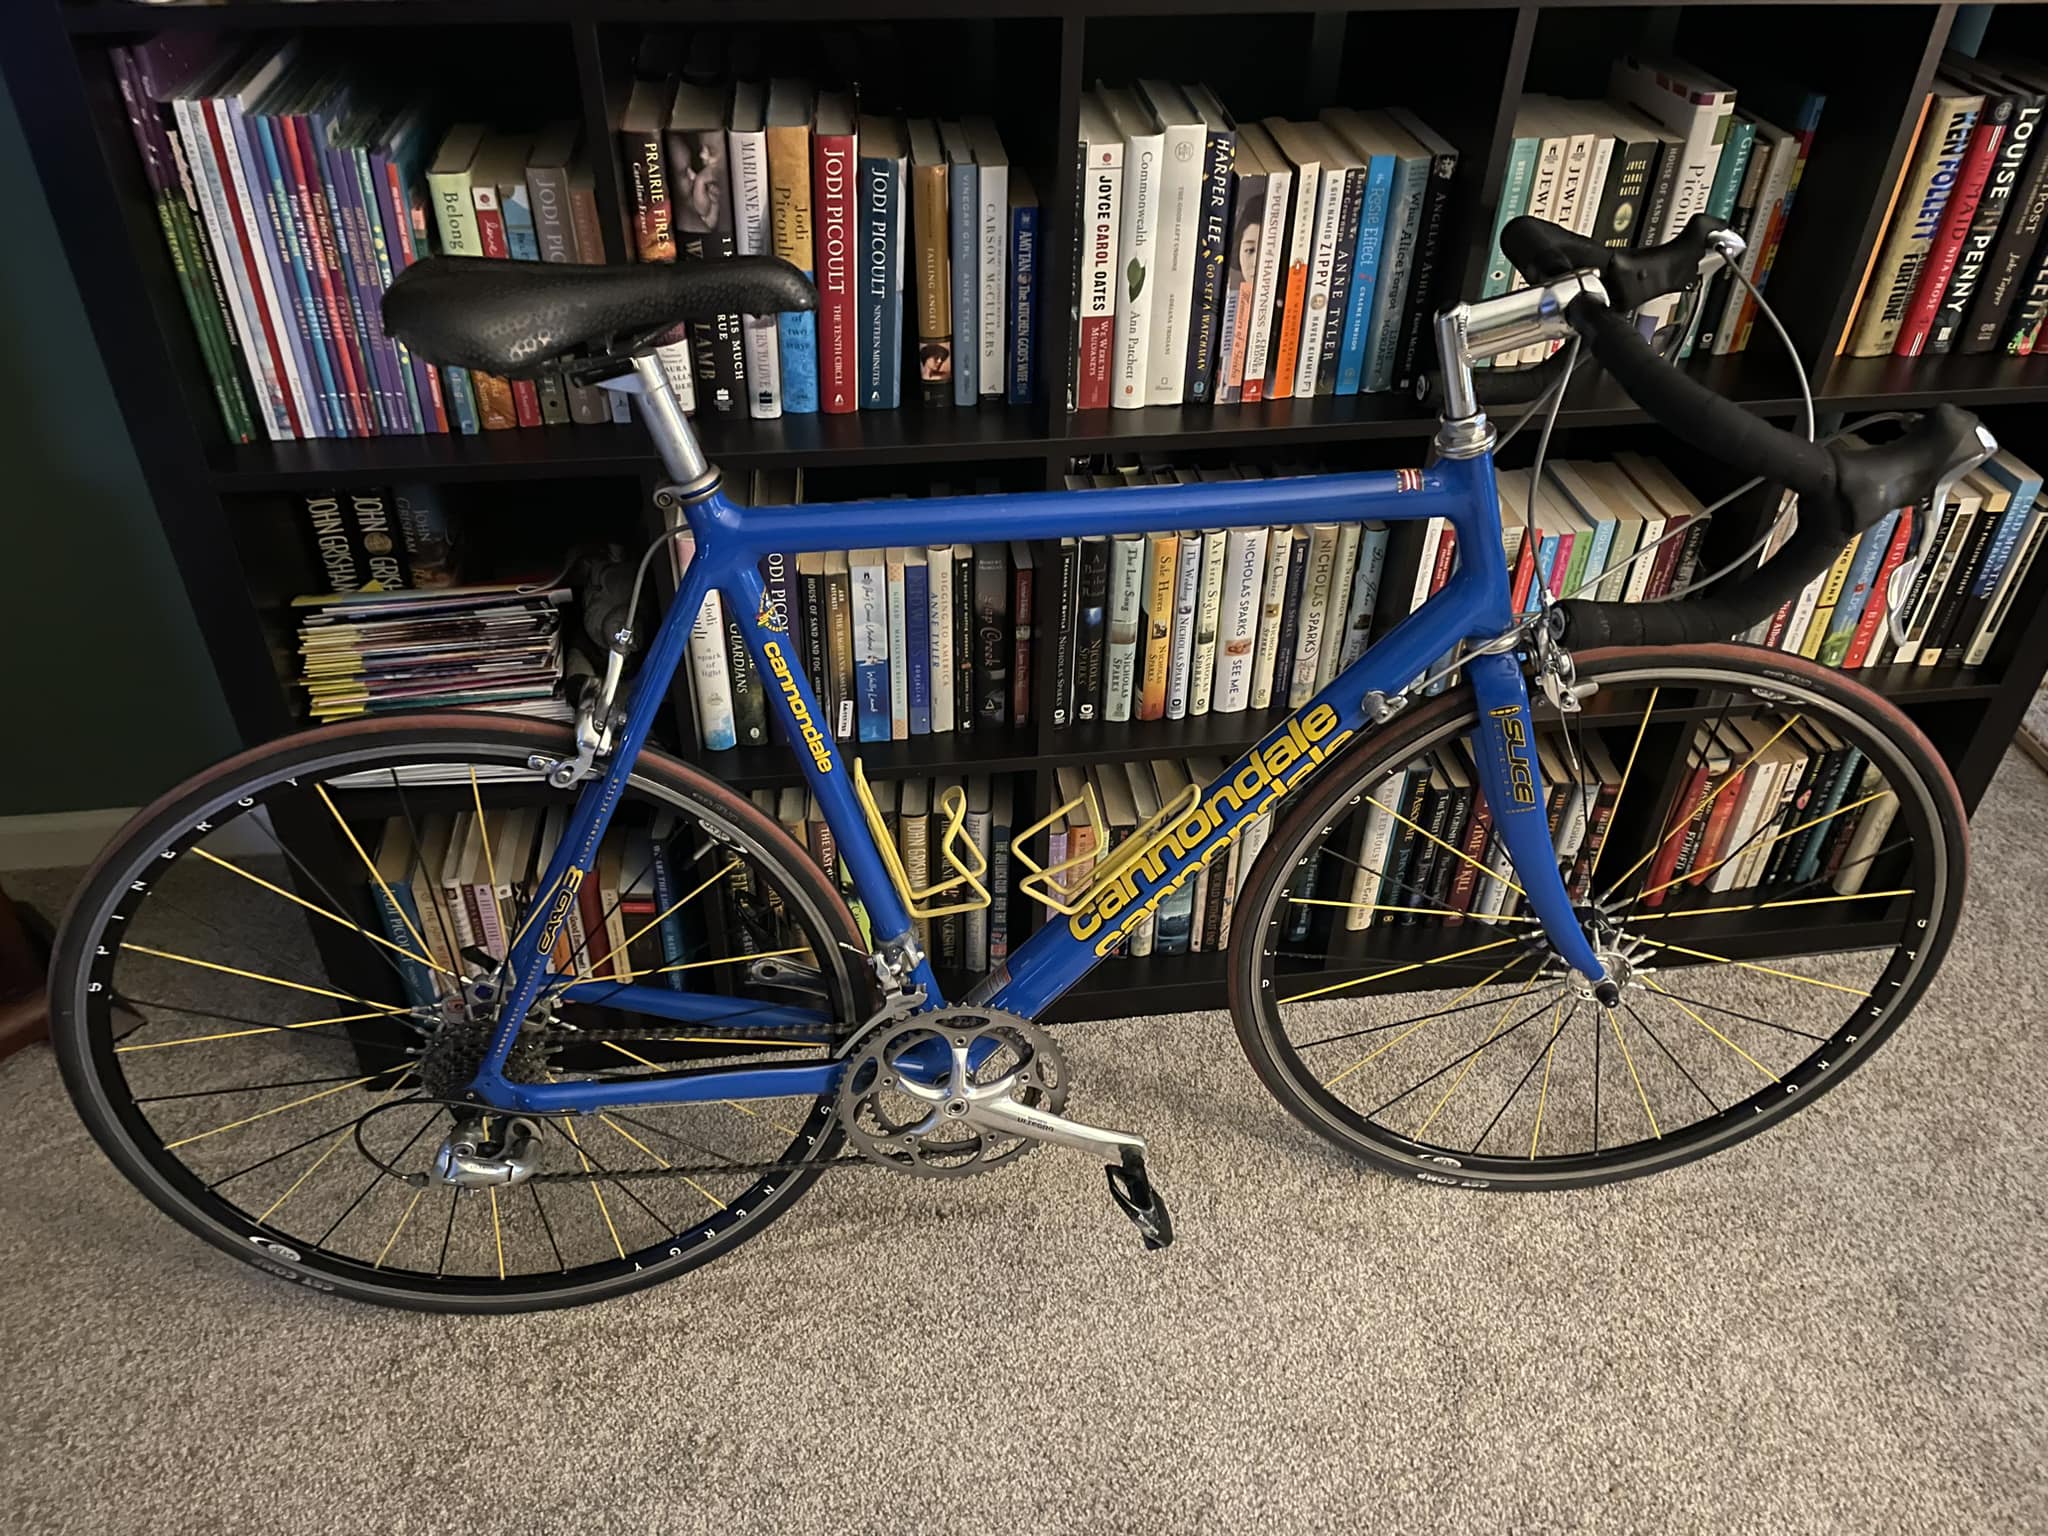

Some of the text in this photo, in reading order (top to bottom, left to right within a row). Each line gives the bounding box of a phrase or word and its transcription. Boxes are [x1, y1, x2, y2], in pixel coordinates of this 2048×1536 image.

[633, 162, 644, 202] Caroline
[1911, 112, 1978, 240] KEN FOLLETT
[1989, 108, 2041, 198] LOUISE
[536, 178, 559, 226] JODI
[645, 143, 669, 250] PRAIRIE FIRES
[1207, 139, 1230, 243] HARPER LEE
[1650, 148, 1677, 224] HOUSE OF SAND
[1950, 183, 1982, 241] MAID
[443, 192, 465, 250] Belong
[794, 206, 808, 240] Jodi
[823, 148, 844, 294] JODI PICOULT
[871, 168, 890, 298] JODI PICOULT
[1093, 175, 1113, 311] JOYCE CAROL OATES
[1360, 227, 1378, 266] Effect
[1387, 192, 1422, 310] What Alice Forgot
[926, 248, 936, 289] FALLING
[984, 204, 996, 358] CARSON McCULLERS
[1125, 151, 1153, 379] Commonwealth Ann Patchett
[1256, 195, 1282, 327] PURSUIT HAPPYNESS
[1314, 243, 1332, 287] ZIPPY
[1415, 262, 1434, 304] ASHES
[1881, 253, 1919, 322] FORTUNE
[1926, 246, 1957, 311] NITA PROSE
[1947, 235, 1988, 313] PENNY
[2005, 252, 2020, 273] Jake
[927, 294, 937, 331] ANGELS
[1017, 302, 1030, 336] KITCHEN
[1197, 264, 1215, 371] GO SET WATCHMAN
[1322, 250, 1349, 361] ANNE TYLER
[694, 323, 716, 380] LAMB
[732, 340, 744, 380] MUCH
[833, 304, 844, 386] THE CIRCLE
[871, 305, 881, 386] NINETEEN MINUTES
[307, 496, 344, 534] JOHN
[352, 495, 389, 532] JOHN
[2008, 496, 2034, 531] COLD
[1156, 556, 1172, 612] Safe Haven
[1270, 543, 1286, 597] The Choice
[1826, 570, 1845, 602] FRANK
[1956, 516, 1996, 595] THE ENGLISH PATIENT
[1978, 535, 2017, 600] MOUNTAIN
[807, 578, 821, 671] HOUSE OF SAND AND FOG
[1230, 539, 1256, 694] NICHOLAS SPARKS SEE ME
[1304, 540, 1332, 654] NICHOLAS SPARKS
[1338, 567, 1352, 618] NOTEBOOK
[1902, 572, 1928, 619] Atonement
[930, 592, 939, 668] ANNE TYLER
[980, 627, 1002, 667] Creek
[1174, 617, 1188, 692] NICHOLAS SPARKS
[1856, 611, 1877, 646] BOAT
[1112, 658, 1122, 692] SPARKS
[1122, 652, 1132, 698] NICHOLAS
[1148, 654, 1157, 682] SPARKS
[1156, 645, 1167, 684] NICHOLAS
[763, 641, 833, 774] cannondale
[1415, 778, 1427, 795] THE
[1503, 718, 1535, 804] SLICE
[820, 828, 832, 866] THE LAST
[1068, 703, 1339, 941] cannondale
[1565, 814, 1586, 849] GRISHAM
[906, 821, 925, 889] JOHN GRISHAM
[1456, 824, 1484, 894] TIME KILL
[634, 1104, 833, 1273] SPNERGY
